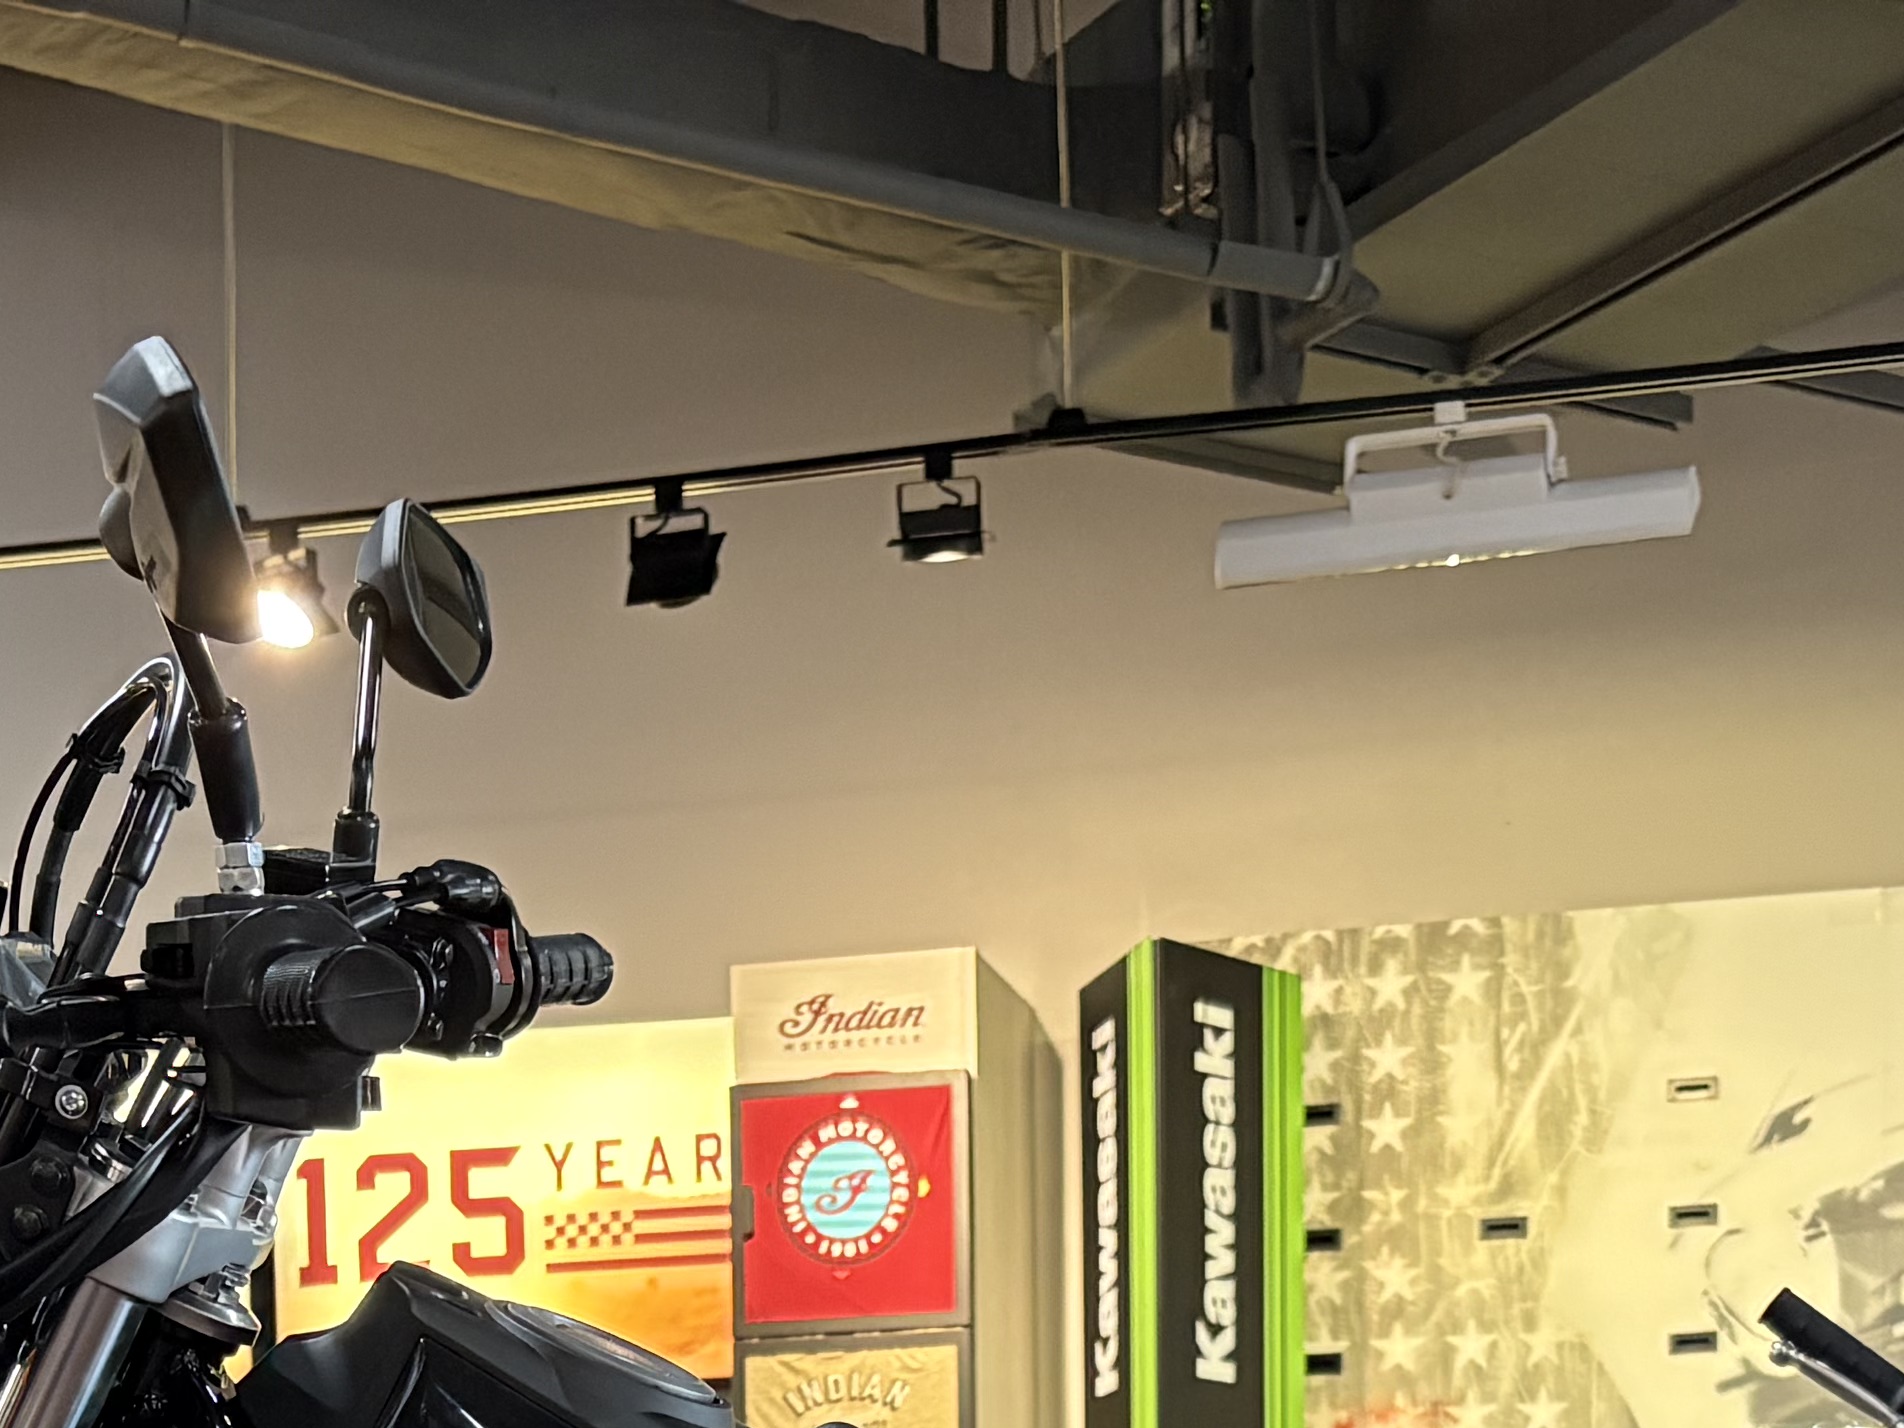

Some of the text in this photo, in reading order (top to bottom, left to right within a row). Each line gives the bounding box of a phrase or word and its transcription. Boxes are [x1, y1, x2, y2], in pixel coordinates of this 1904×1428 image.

[778, 993, 926, 1039] Indian
[296, 1146, 526, 1289] 125
[1090, 1015, 1120, 1398] Kawasaki
[1193, 996, 1237, 1385] Kawasaki
[783, 1371, 912, 1416] INDIAN
